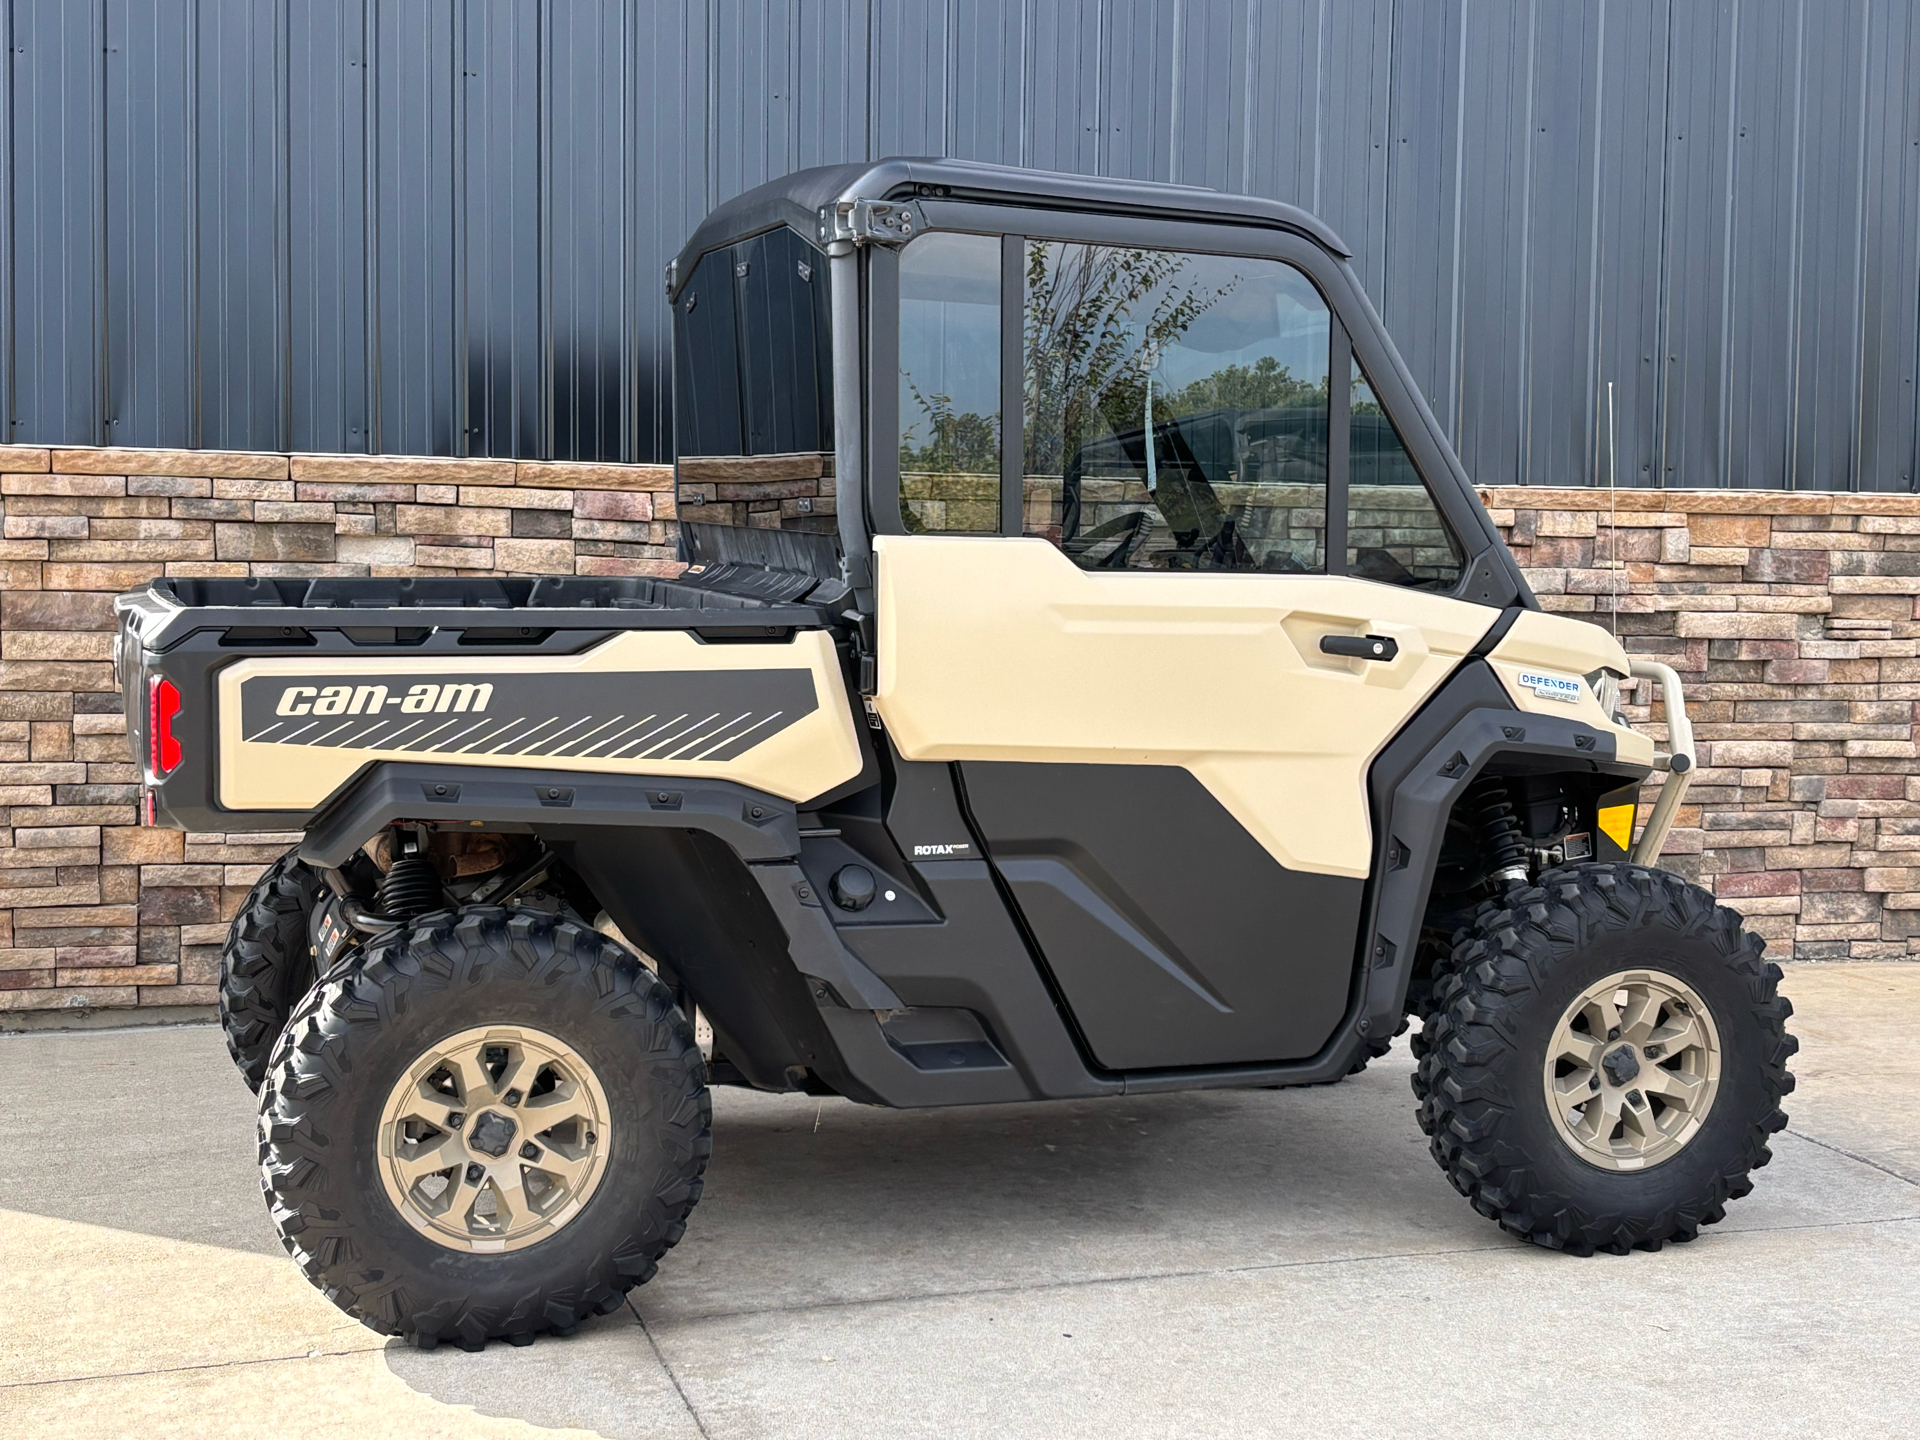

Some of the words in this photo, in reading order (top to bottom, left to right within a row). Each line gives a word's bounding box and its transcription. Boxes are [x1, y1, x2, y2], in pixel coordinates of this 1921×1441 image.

[1522, 674, 1579, 691] DEFENDER
[276, 683, 494, 716] can-am
[914, 844, 954, 856] ROTAX
